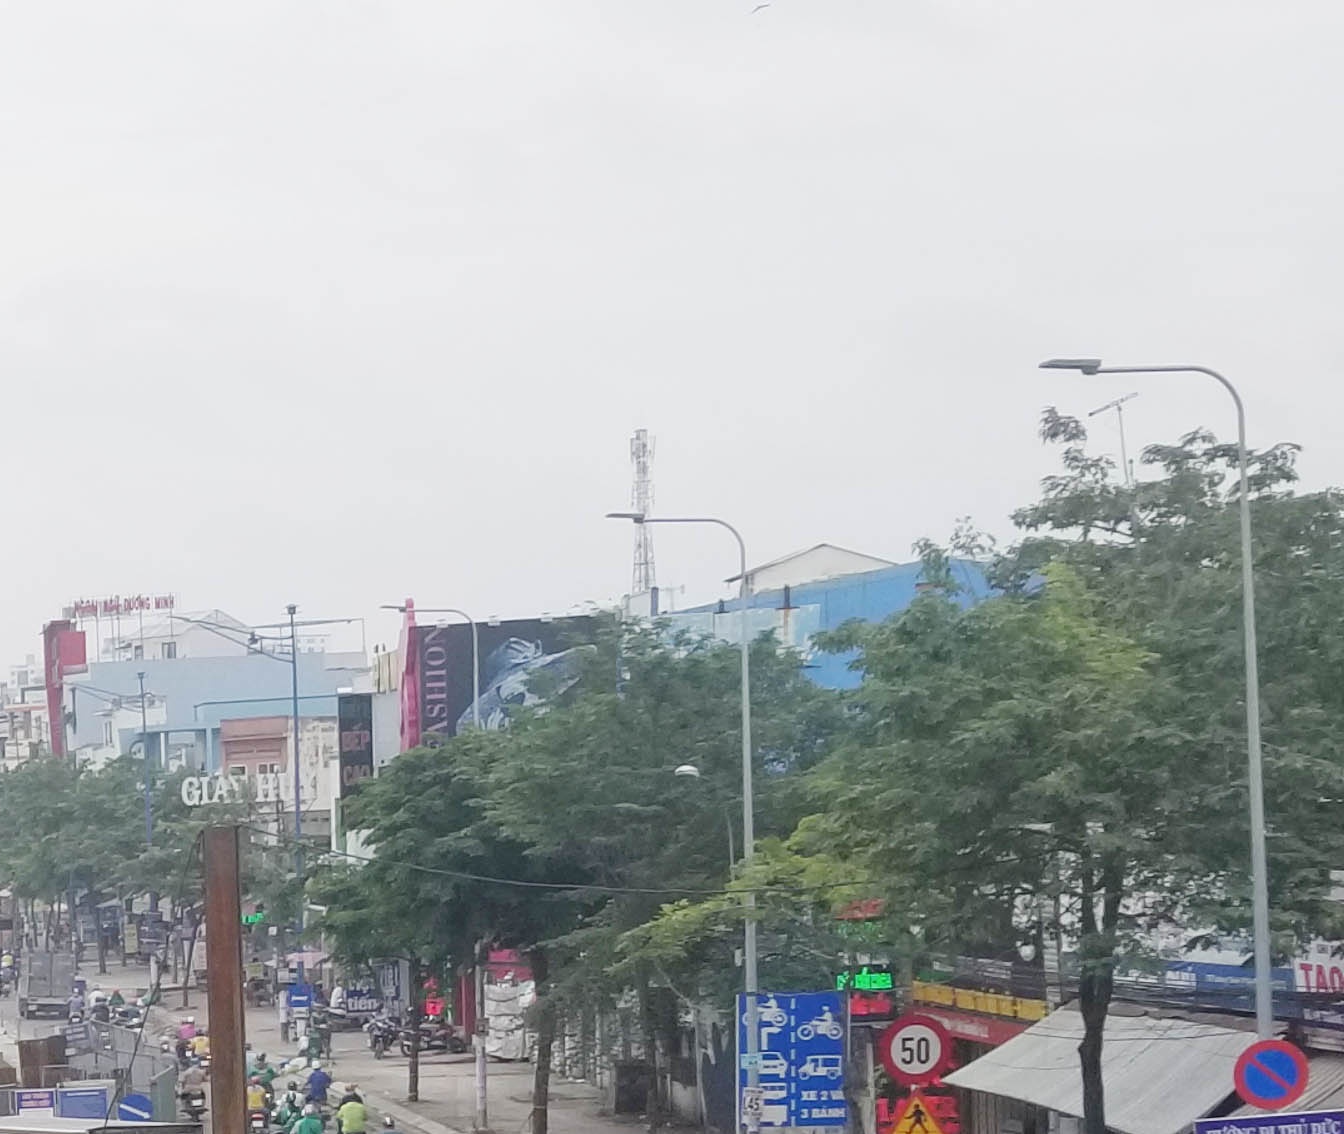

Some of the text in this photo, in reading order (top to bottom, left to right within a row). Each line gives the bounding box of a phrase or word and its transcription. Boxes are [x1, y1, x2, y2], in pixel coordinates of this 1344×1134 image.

[423, 627, 449, 748] ASHION
[901, 1037, 930, 1064] 50
[801, 1090, 818, 1101] XE
[820, 1090, 828, 1101] 2
[800, 1109, 809, 1119] 3
